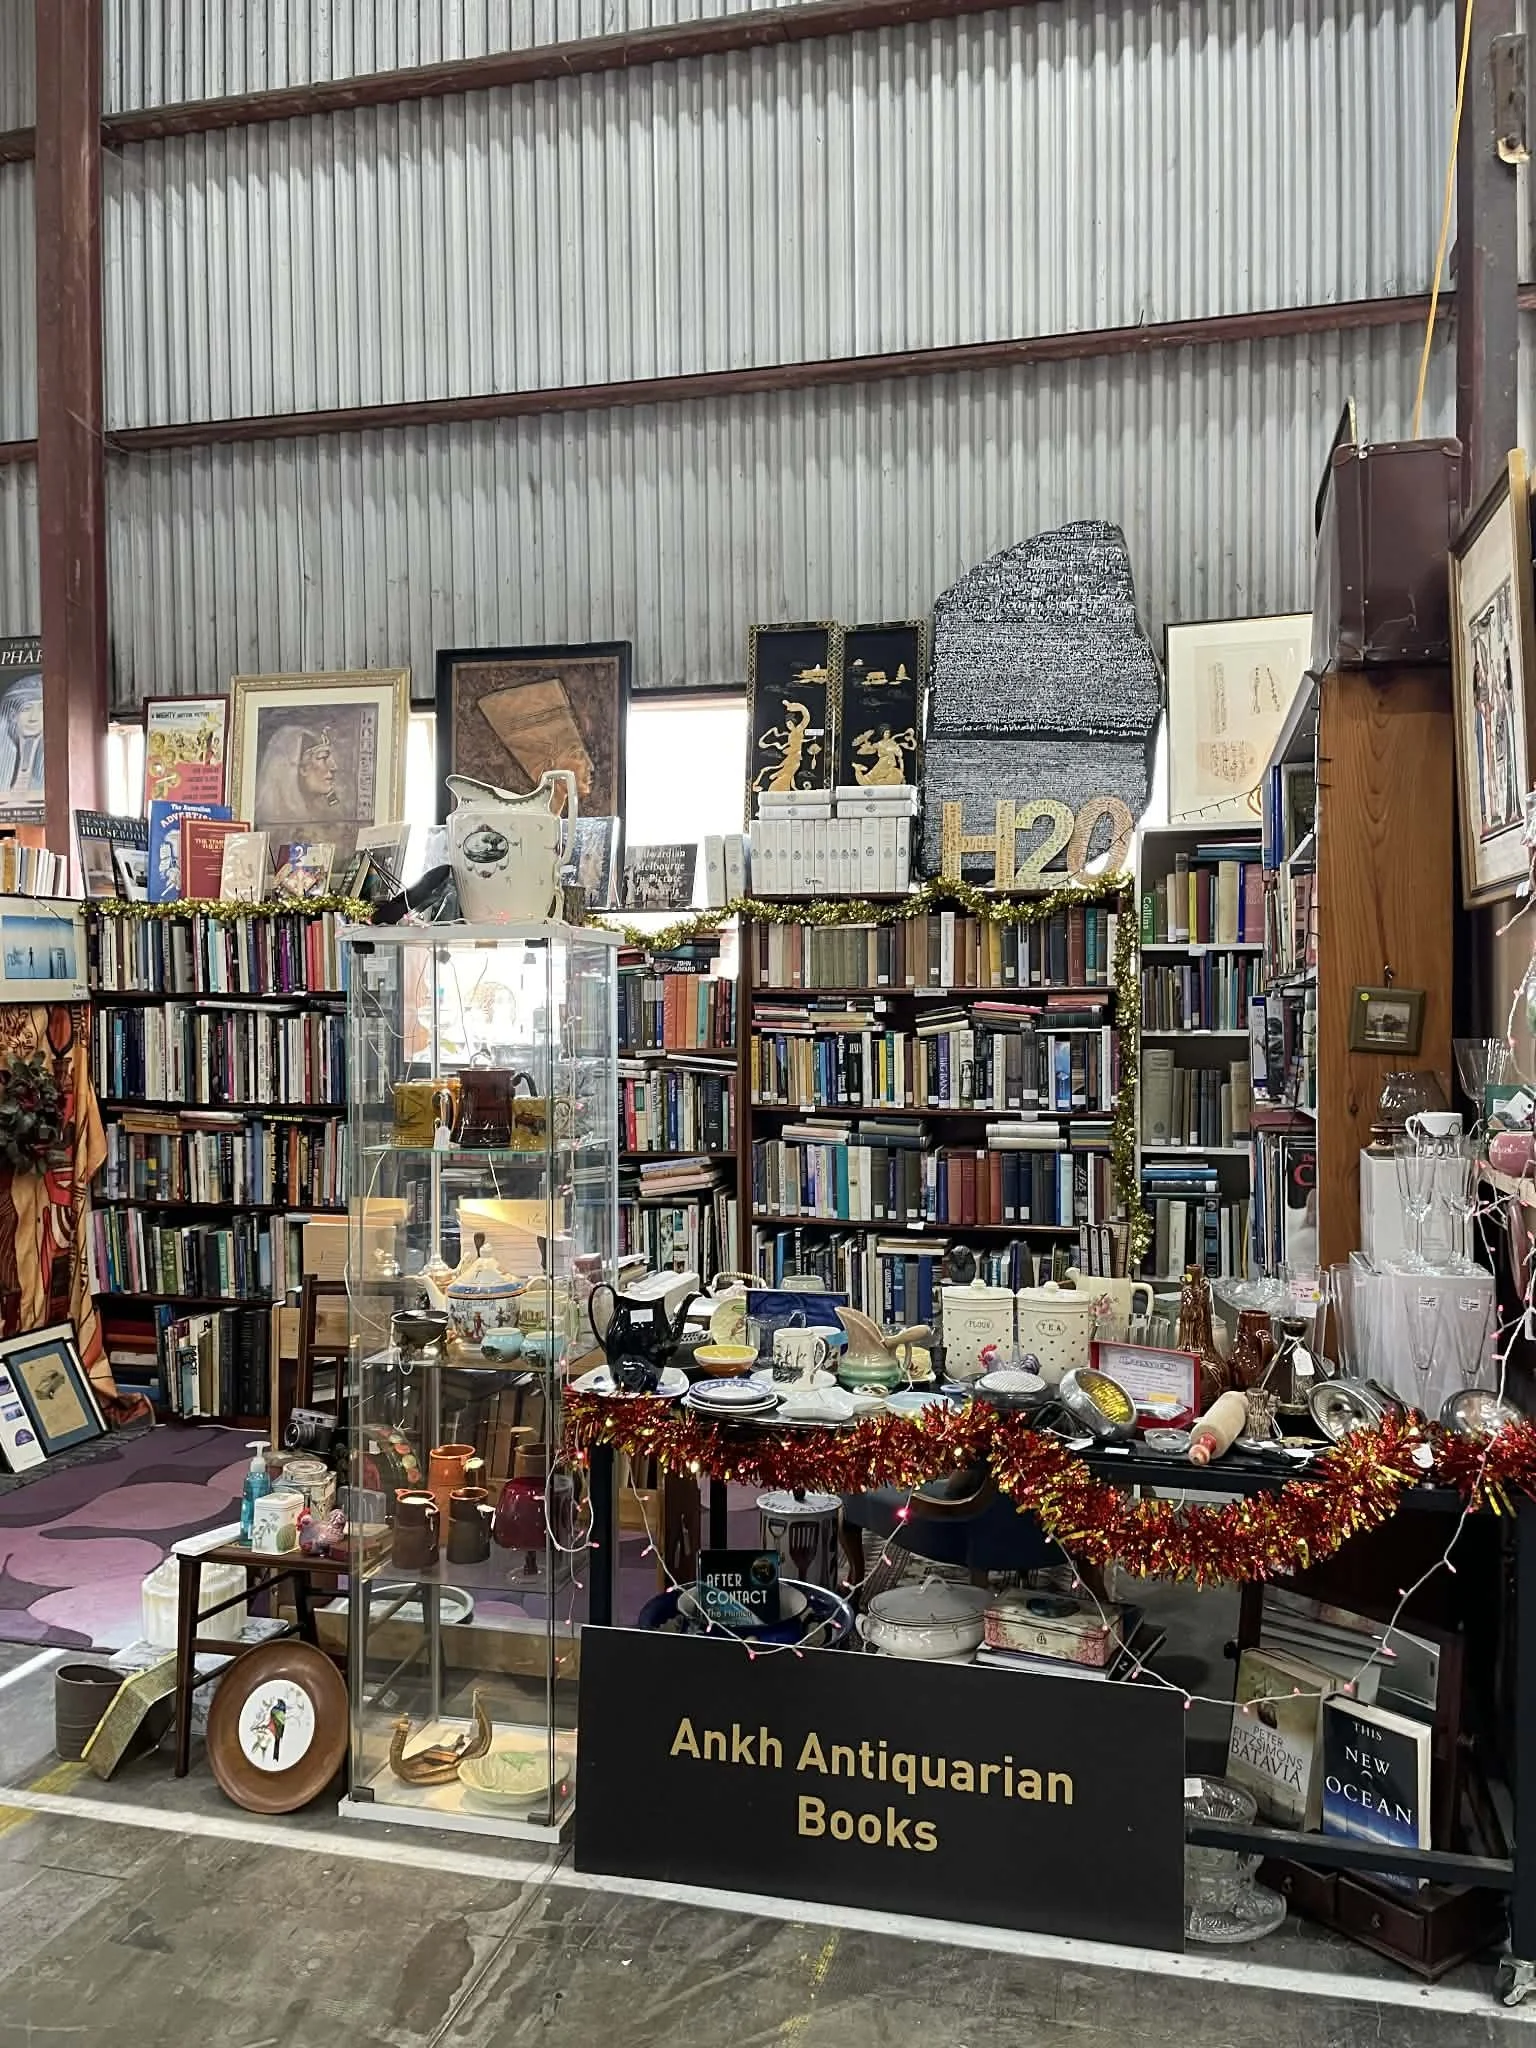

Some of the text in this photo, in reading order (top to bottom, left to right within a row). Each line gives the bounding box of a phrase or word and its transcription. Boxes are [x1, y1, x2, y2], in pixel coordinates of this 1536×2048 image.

[1143, 896, 1152, 930] Collins
[968, 1321, 992, 1329] FLOUR
[1041, 1323, 1062, 1332] TEA
[706, 1573, 742, 1587] AFTER
[706, 1590, 768, 1604] CONTACT
[1233, 1725, 1304, 1771] FITZSIMONS
[1253, 1725, 1283, 1746] PETER
[1353, 1721, 1383, 1743] THIS
[670, 1717, 1075, 1806] Ankh Antiquarian
[1231, 1737, 1302, 1793] BATAVIA
[1344, 1745, 1391, 1777] NEW
[1325, 1776, 1414, 1826] OCEAN
[797, 1794, 938, 1853] Books
